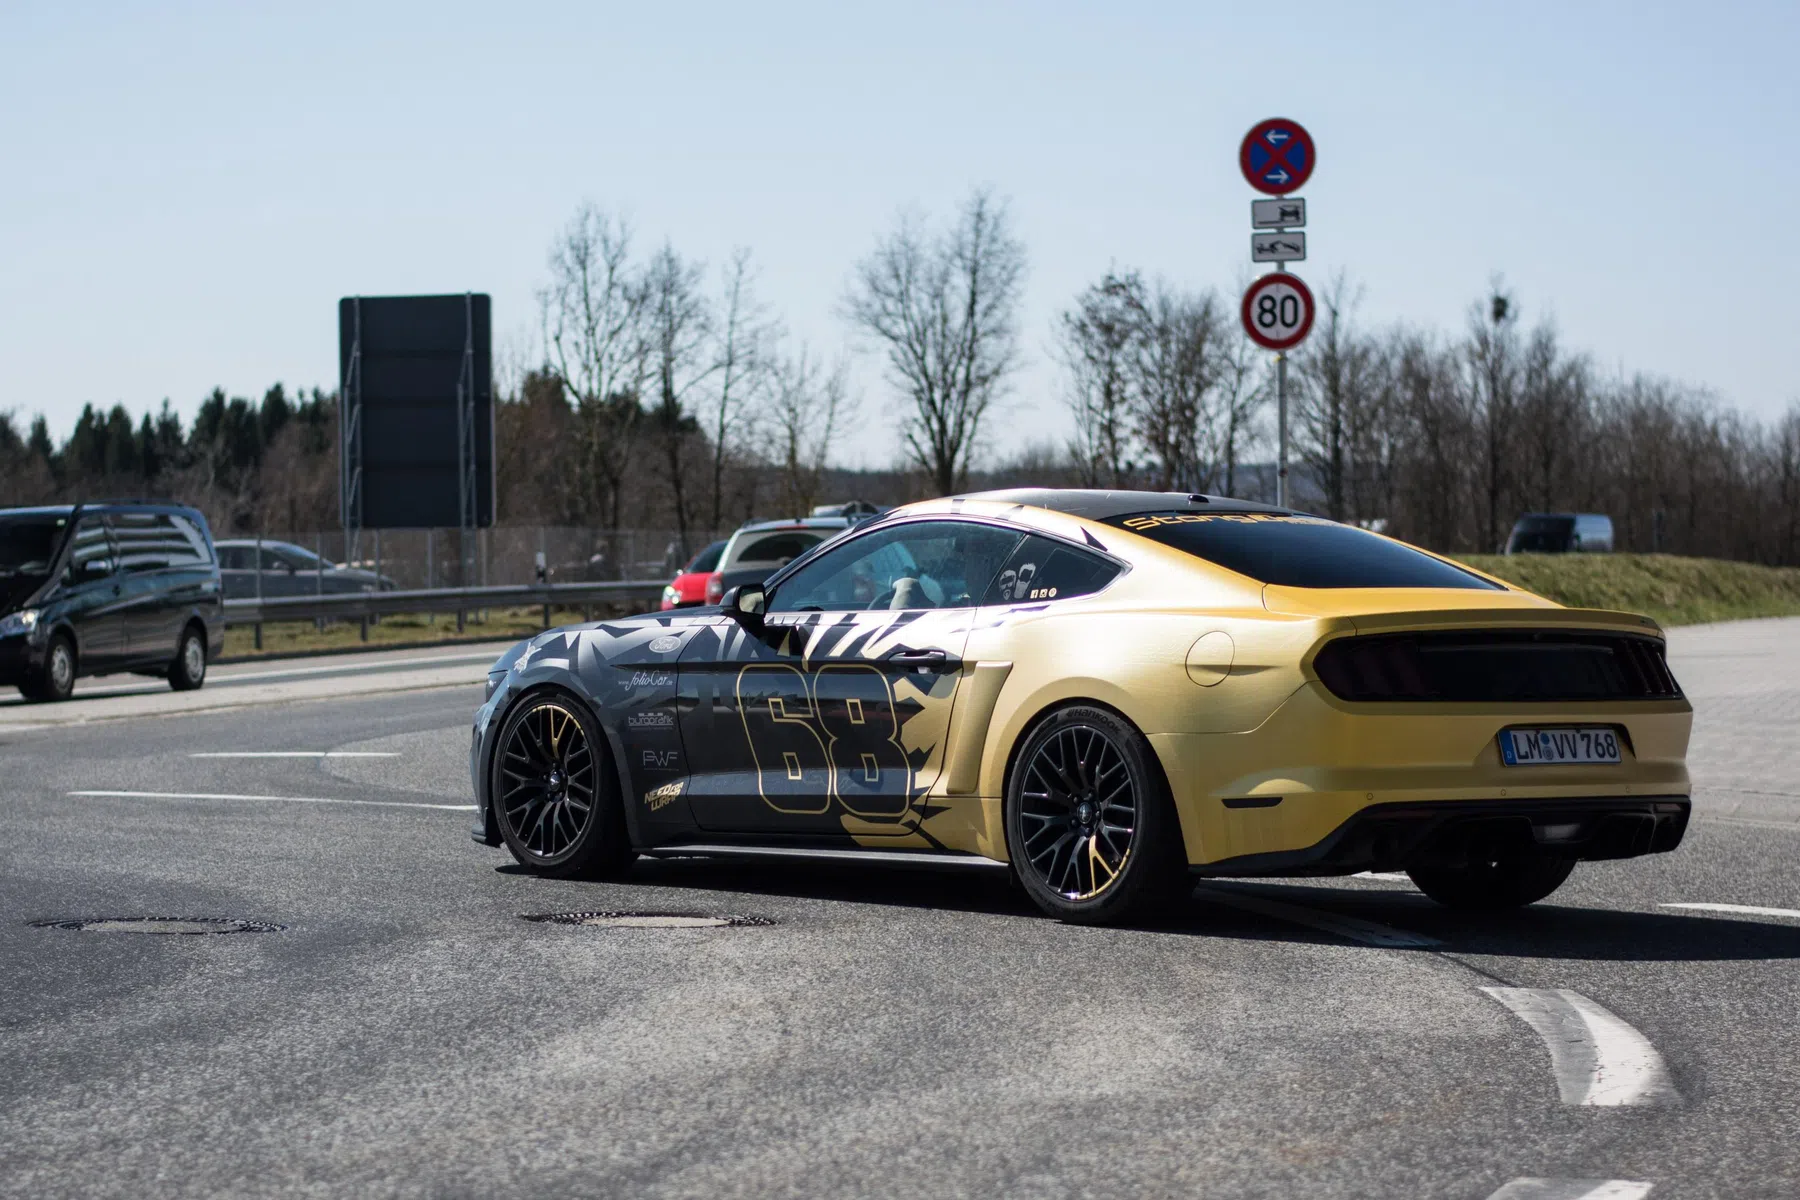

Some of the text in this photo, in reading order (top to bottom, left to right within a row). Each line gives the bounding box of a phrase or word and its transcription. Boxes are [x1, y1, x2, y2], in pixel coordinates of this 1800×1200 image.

[1257, 294, 1299, 328] 80
[736, 663, 911, 817] 68
[1512, 733, 1617, 759] LM VV 768
